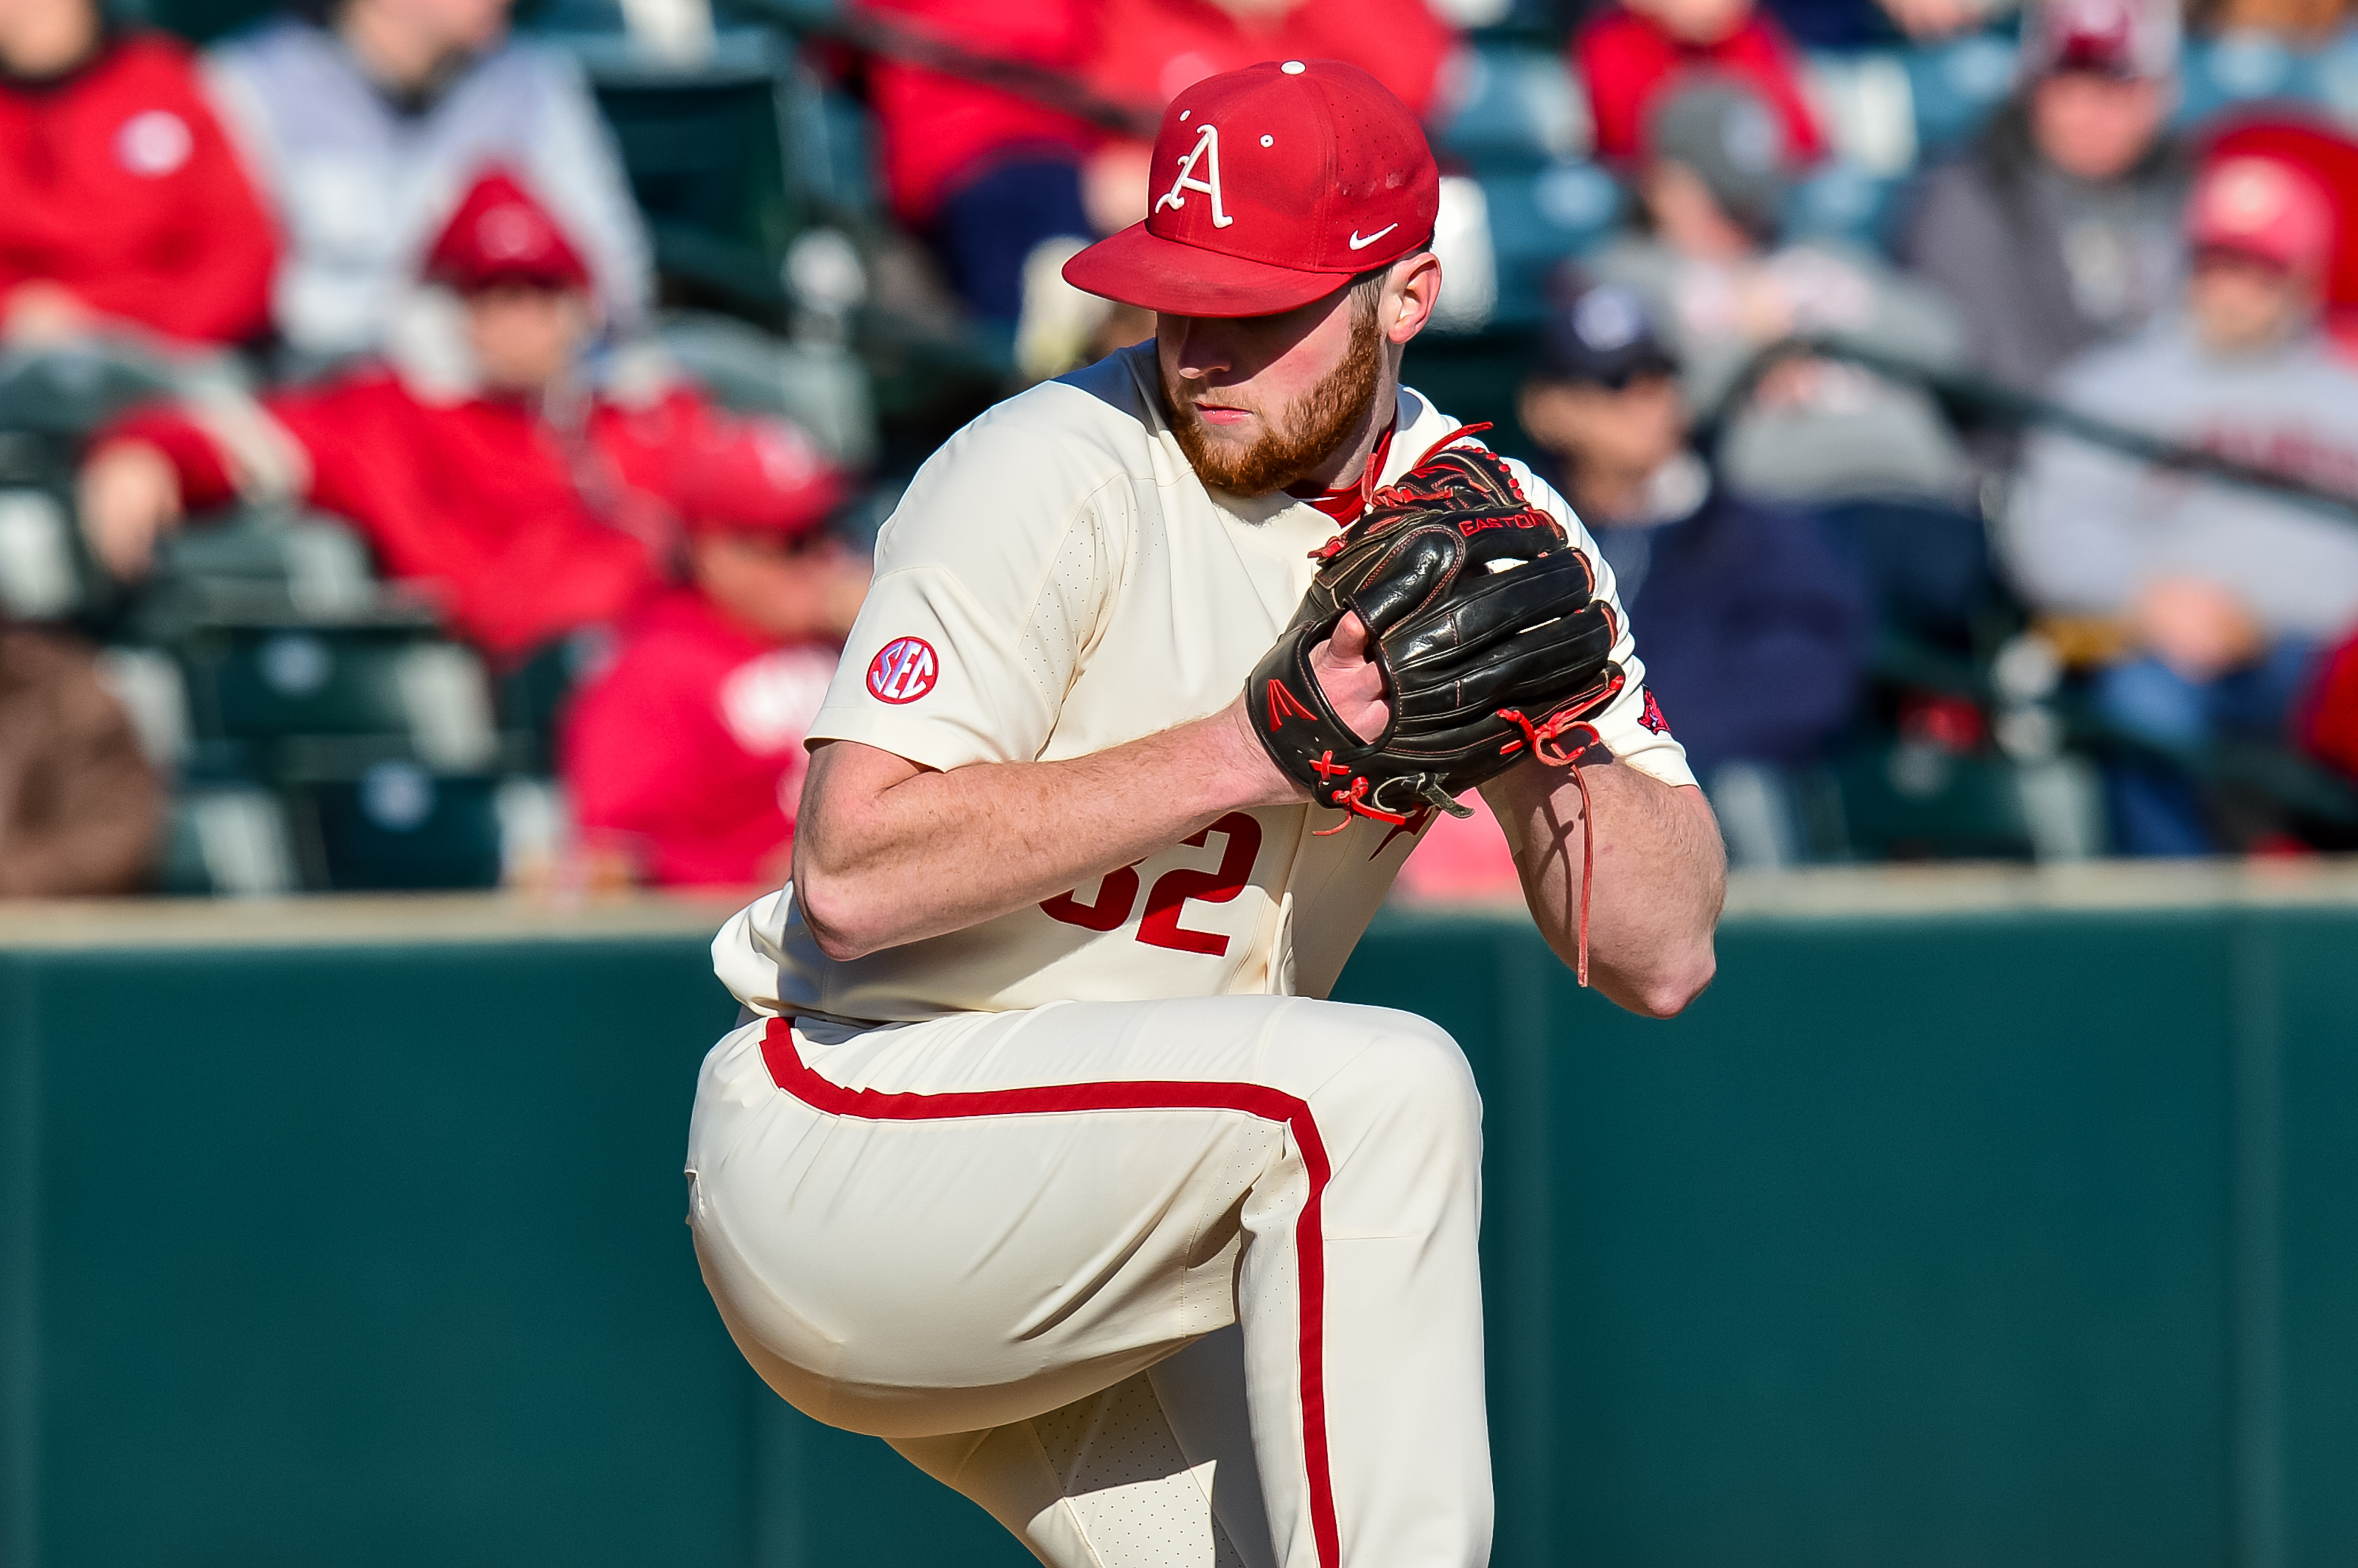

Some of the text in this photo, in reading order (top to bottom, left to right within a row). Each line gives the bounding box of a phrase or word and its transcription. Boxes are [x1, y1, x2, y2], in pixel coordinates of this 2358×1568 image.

[1154, 123, 1234, 228] A
[1458, 513, 1549, 537] EASTON
[871, 640, 934, 700] SEC
